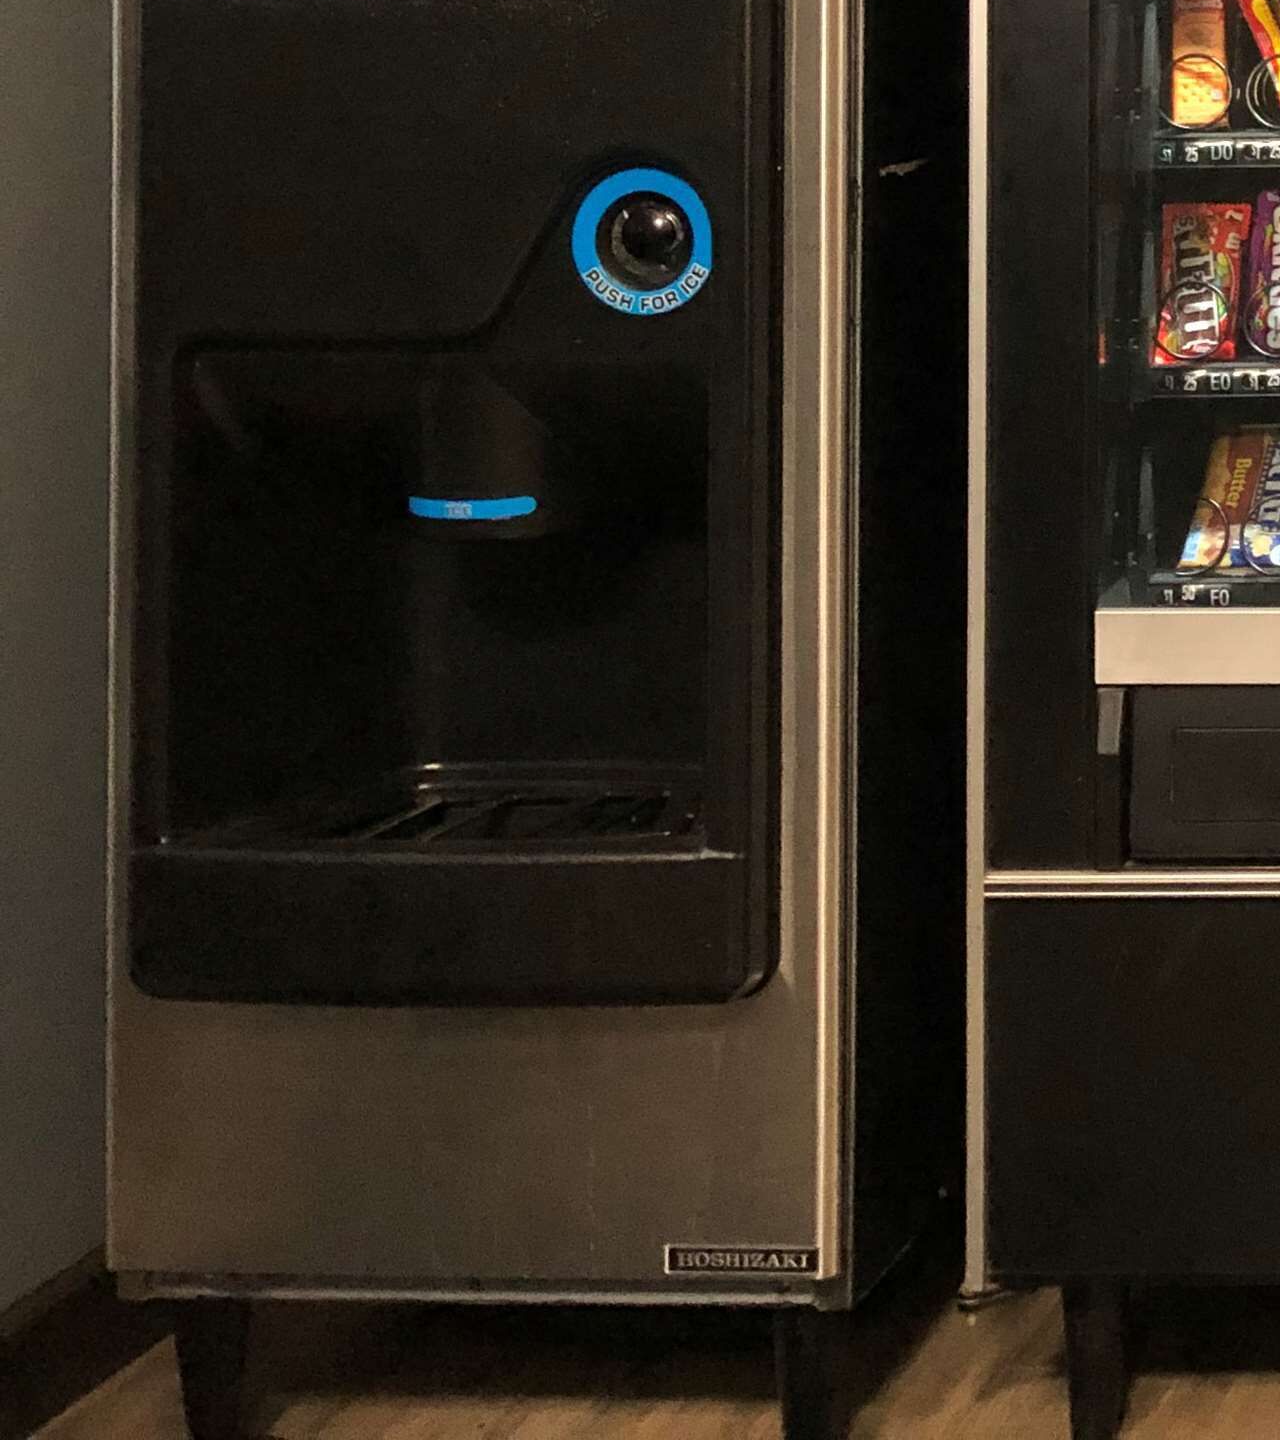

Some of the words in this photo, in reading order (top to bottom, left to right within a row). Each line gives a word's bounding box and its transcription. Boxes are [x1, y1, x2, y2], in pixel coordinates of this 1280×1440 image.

[1209, 144, 1234, 160] D0
[585, 269, 634, 310] PUSH
[639, 290, 681, 312] FOR
[679, 263, 708, 295] ICE
[1209, 371, 1232, 392] E0
[1224, 457, 1253, 509] Butter
[1209, 589, 1230, 607] F0
[676, 1251, 810, 1269] HOSHIZAKI
